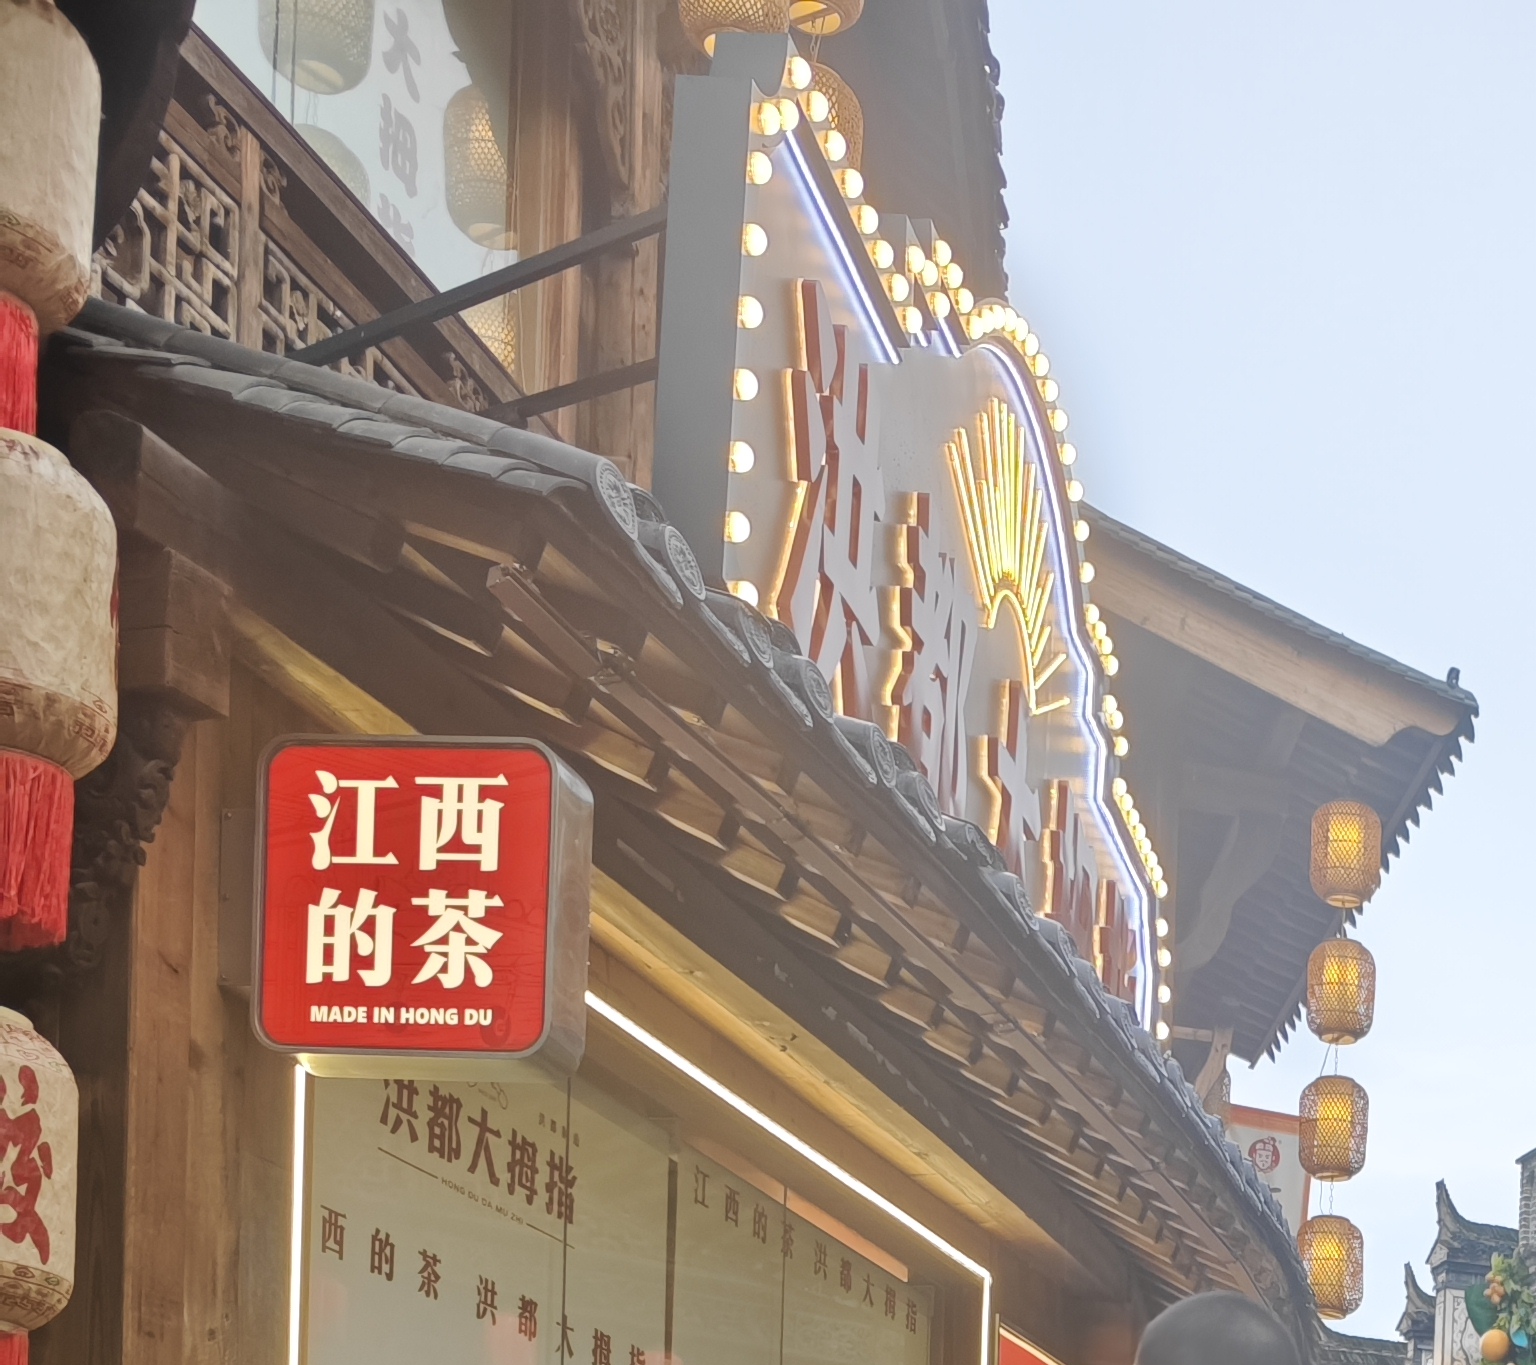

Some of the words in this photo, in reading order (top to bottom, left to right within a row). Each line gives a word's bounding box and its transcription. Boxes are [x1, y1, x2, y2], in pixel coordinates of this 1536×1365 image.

[307, 769, 510, 872] 江西
[304, 886, 506, 990] 的茶
[309, 1005, 368, 1024] MADE
[372, 1006, 396, 1025] IN
[399, 1007, 459, 1026] HONG
[463, 1008, 493, 1027] DU
[379, 1078, 578, 1225] 洪都大拇指
[441, 1177, 466, 1196] HONG
[467, 1191, 480, 1203] DU
[481, 1197, 493, 1210] DA
[495, 1204, 509, 1217] MU
[320, 1204, 442, 1301] 西的茶
[693, 1164, 796, 1260] 江西的茶
[814, 1239, 918, 1335] 洪都大拇指
